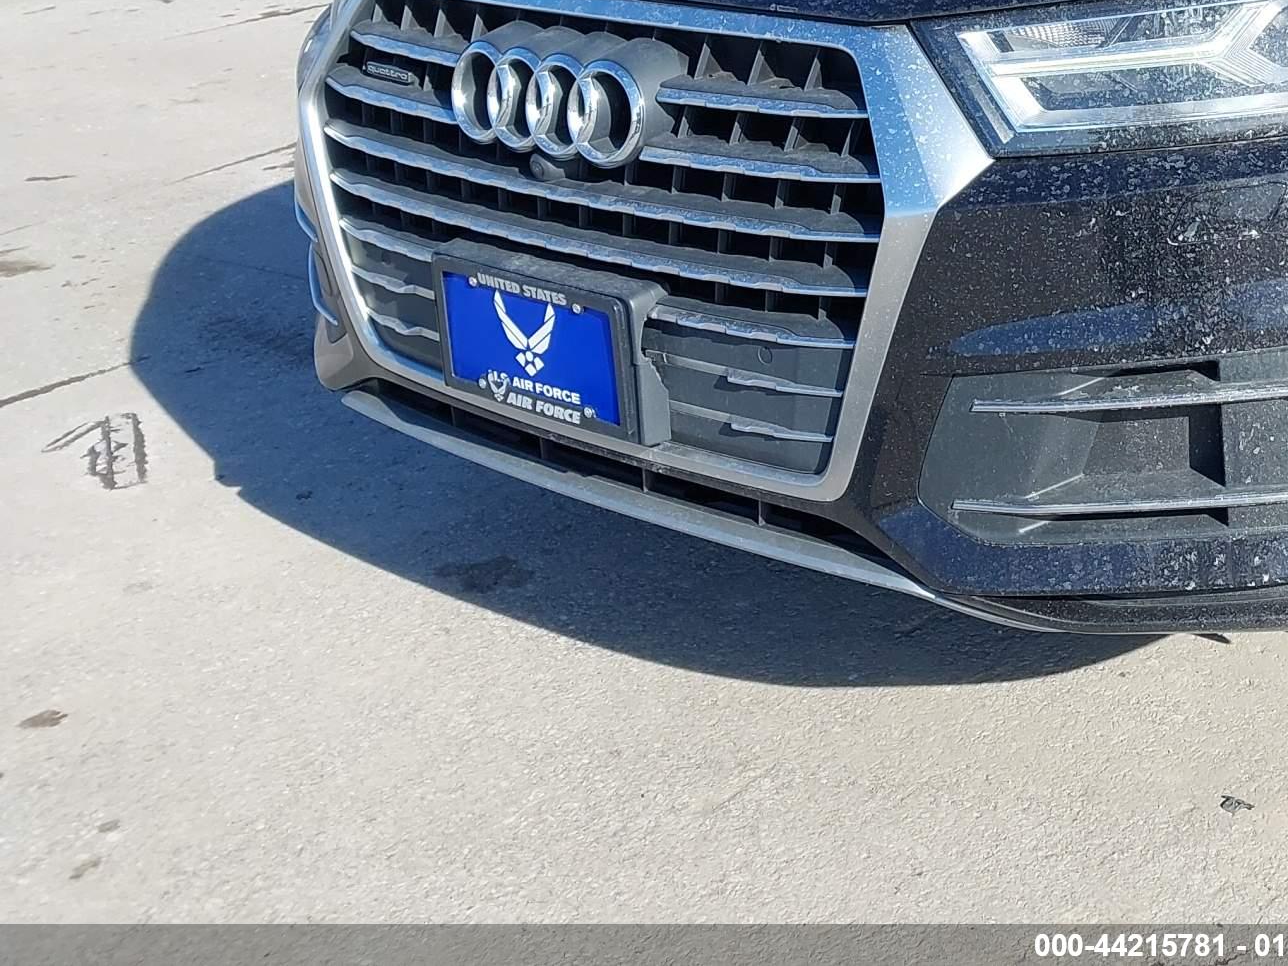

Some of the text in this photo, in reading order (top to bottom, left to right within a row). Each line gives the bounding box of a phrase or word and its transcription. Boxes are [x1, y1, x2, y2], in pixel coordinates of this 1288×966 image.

[367, 65, 408, 80] quattro
[477, 272, 568, 307] UNITED STATES
[512, 376, 534, 393] AIR
[535, 381, 582, 405] FORCE
[506, 391, 581, 425] AIR FORCE
